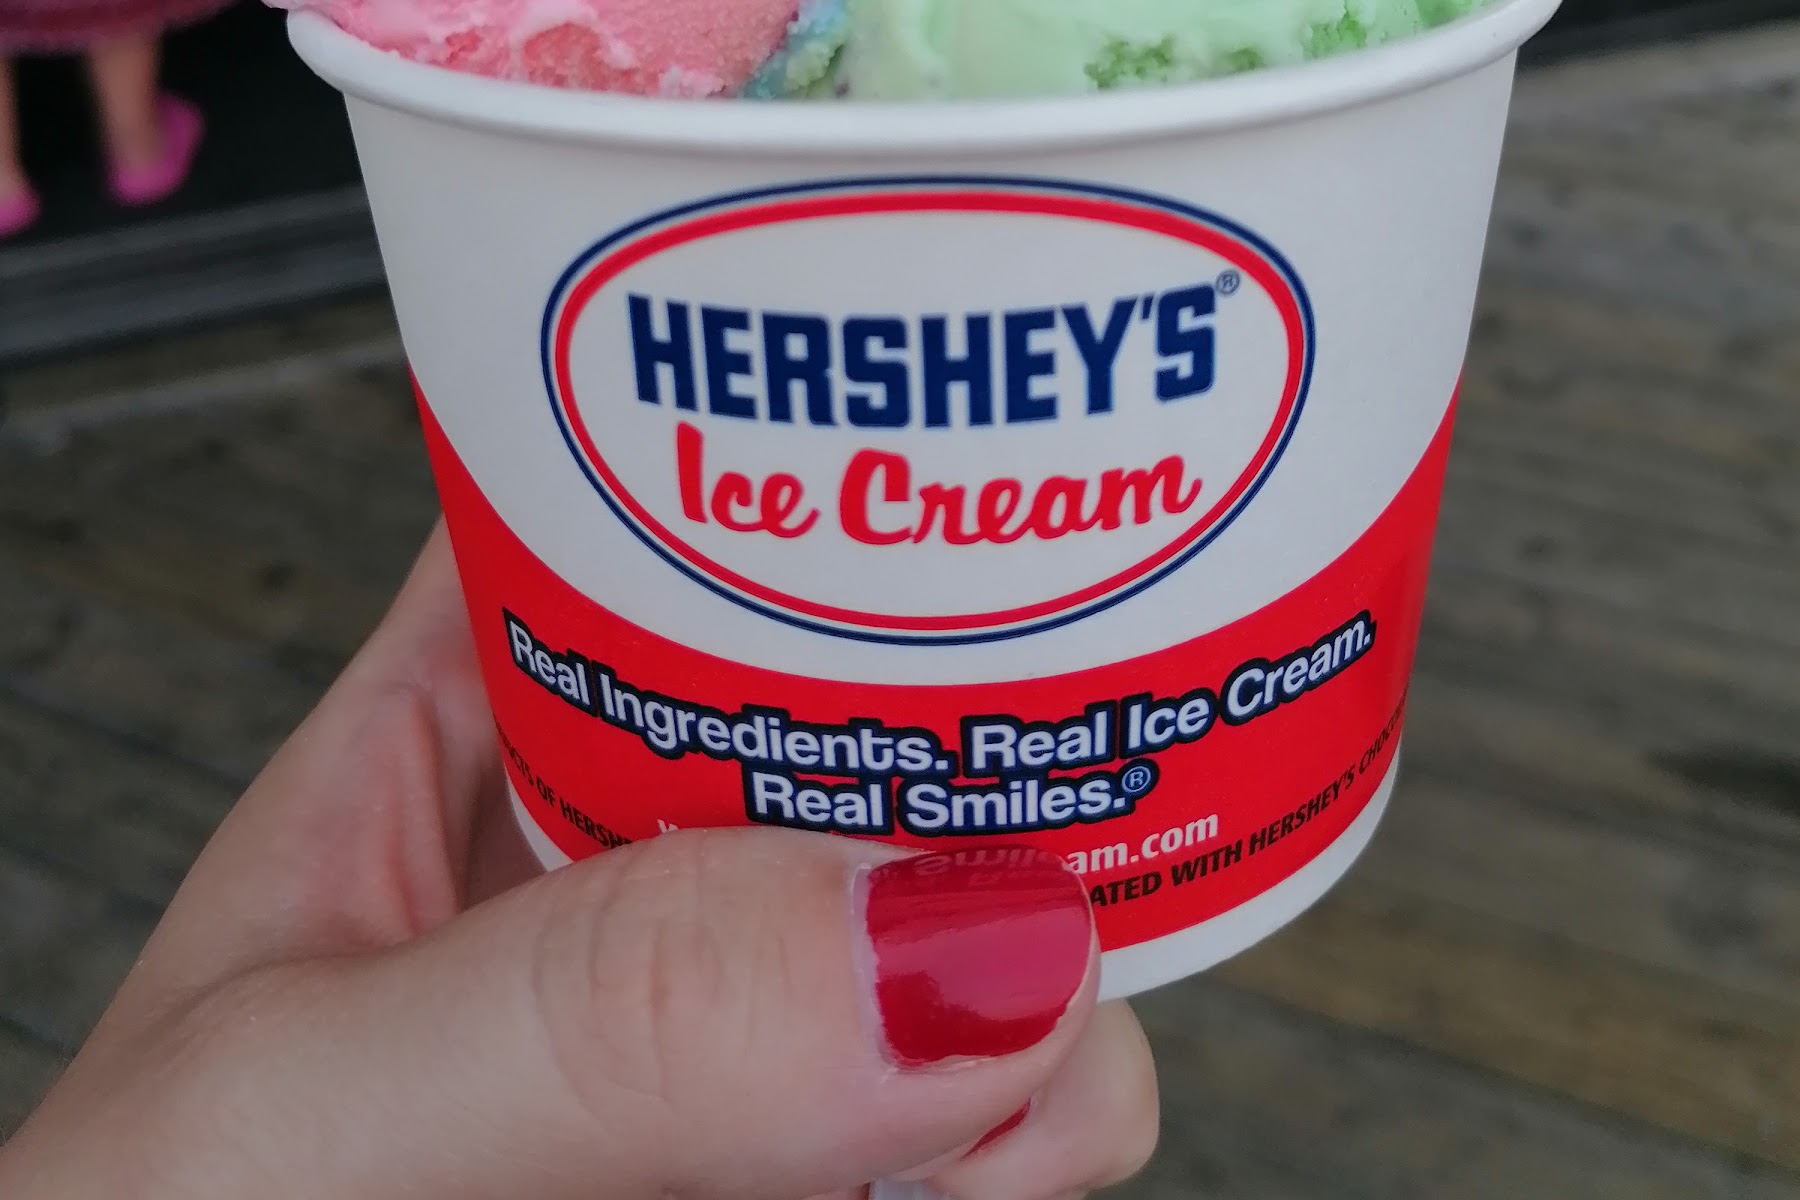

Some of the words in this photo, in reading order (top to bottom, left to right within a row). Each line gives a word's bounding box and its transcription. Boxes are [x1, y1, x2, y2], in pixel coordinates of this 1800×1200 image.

[675, 421, 819, 539] Ice
[838, 448, 1202, 546] Cream
[508, 618, 592, 708] Real
[599, 672, 950, 773] Ingredients.
[970, 709, 1108, 772] Real
[1127, 696, 1211, 751] Ice
[1226, 618, 1373, 719] Cream.
[559, 796, 634, 851] HERSH
[1088, 870, 1164, 908] ATED
[1170, 837, 1244, 889] WITH
[1248, 763, 1357, 857] HERSHEY'S
[751, 770, 886, 829] Real
[1063, 813, 1220, 876] am.com
